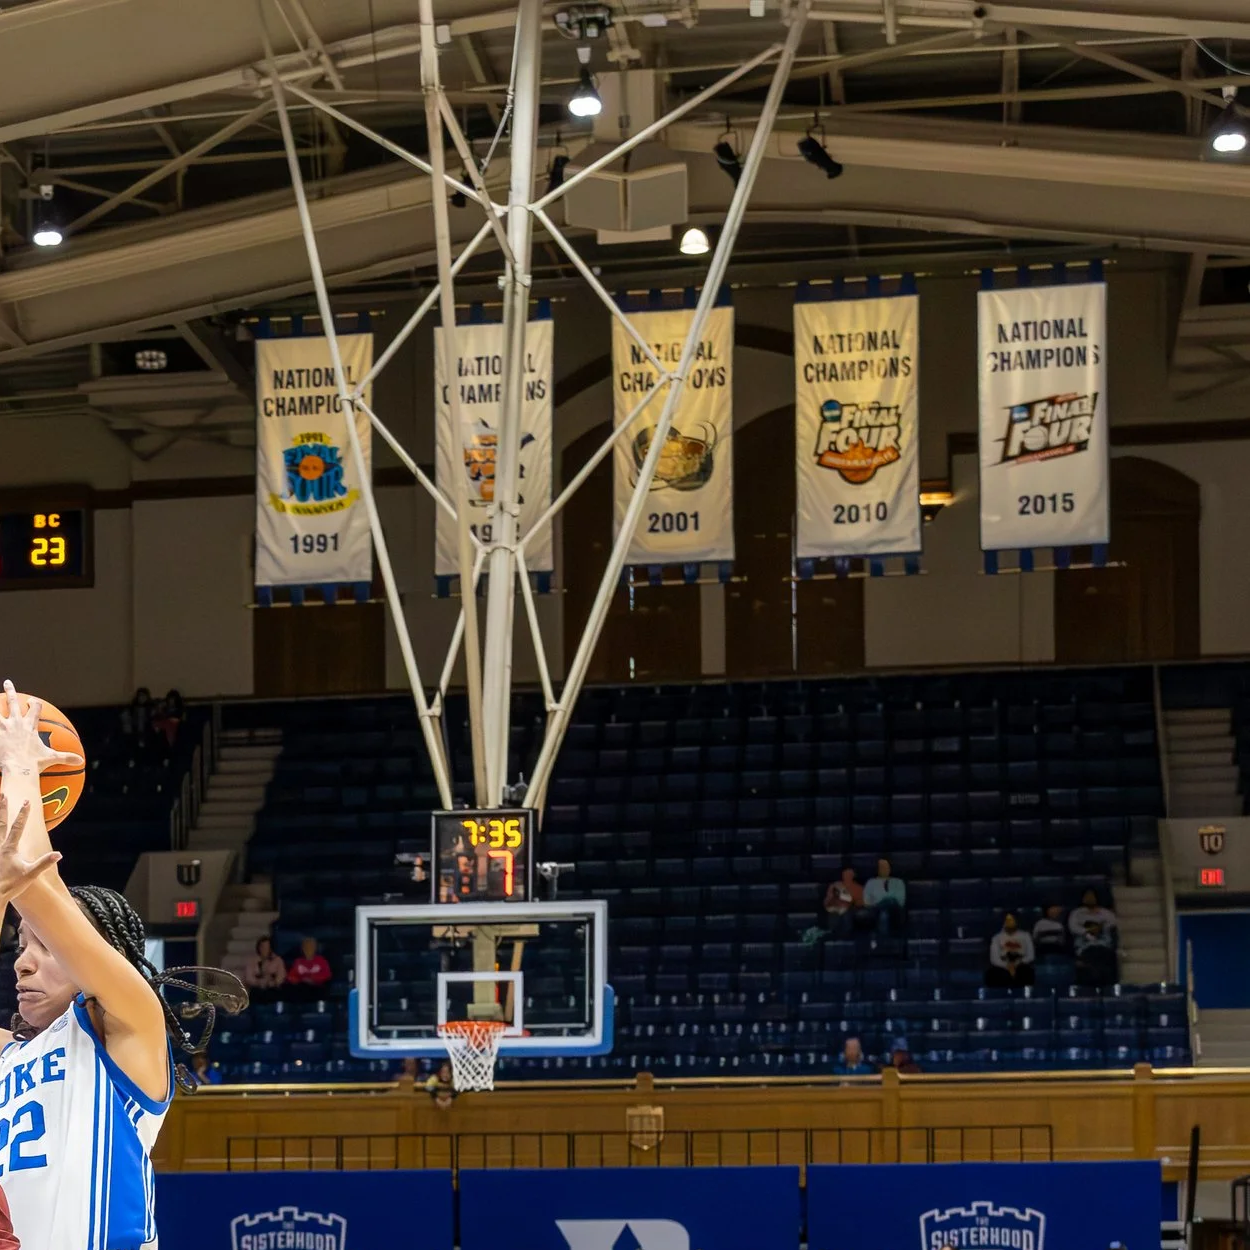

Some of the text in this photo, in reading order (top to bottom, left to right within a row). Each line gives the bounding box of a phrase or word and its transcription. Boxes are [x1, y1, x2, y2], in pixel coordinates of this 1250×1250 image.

[813, 329, 900, 355] NATIONAL
[998, 317, 1088, 343] NATIONAL
[803, 356, 912, 383] CHAMPIONS
[987, 344, 1100, 373] CHAMPIONS
[272, 365, 357, 390] NATIONL
[442, 379, 546, 405] CHAMPNS
[832, 501, 888, 524] 2010
[1017, 493, 1075, 516] 2015
[33, 514, 61, 529] BC
[647, 511, 700, 533] 2001
[31, 537, 66, 566] 23
[289, 532, 340, 554] 1991
[461, 819, 522, 848] 7:35
[487, 849, 515, 897] 7
